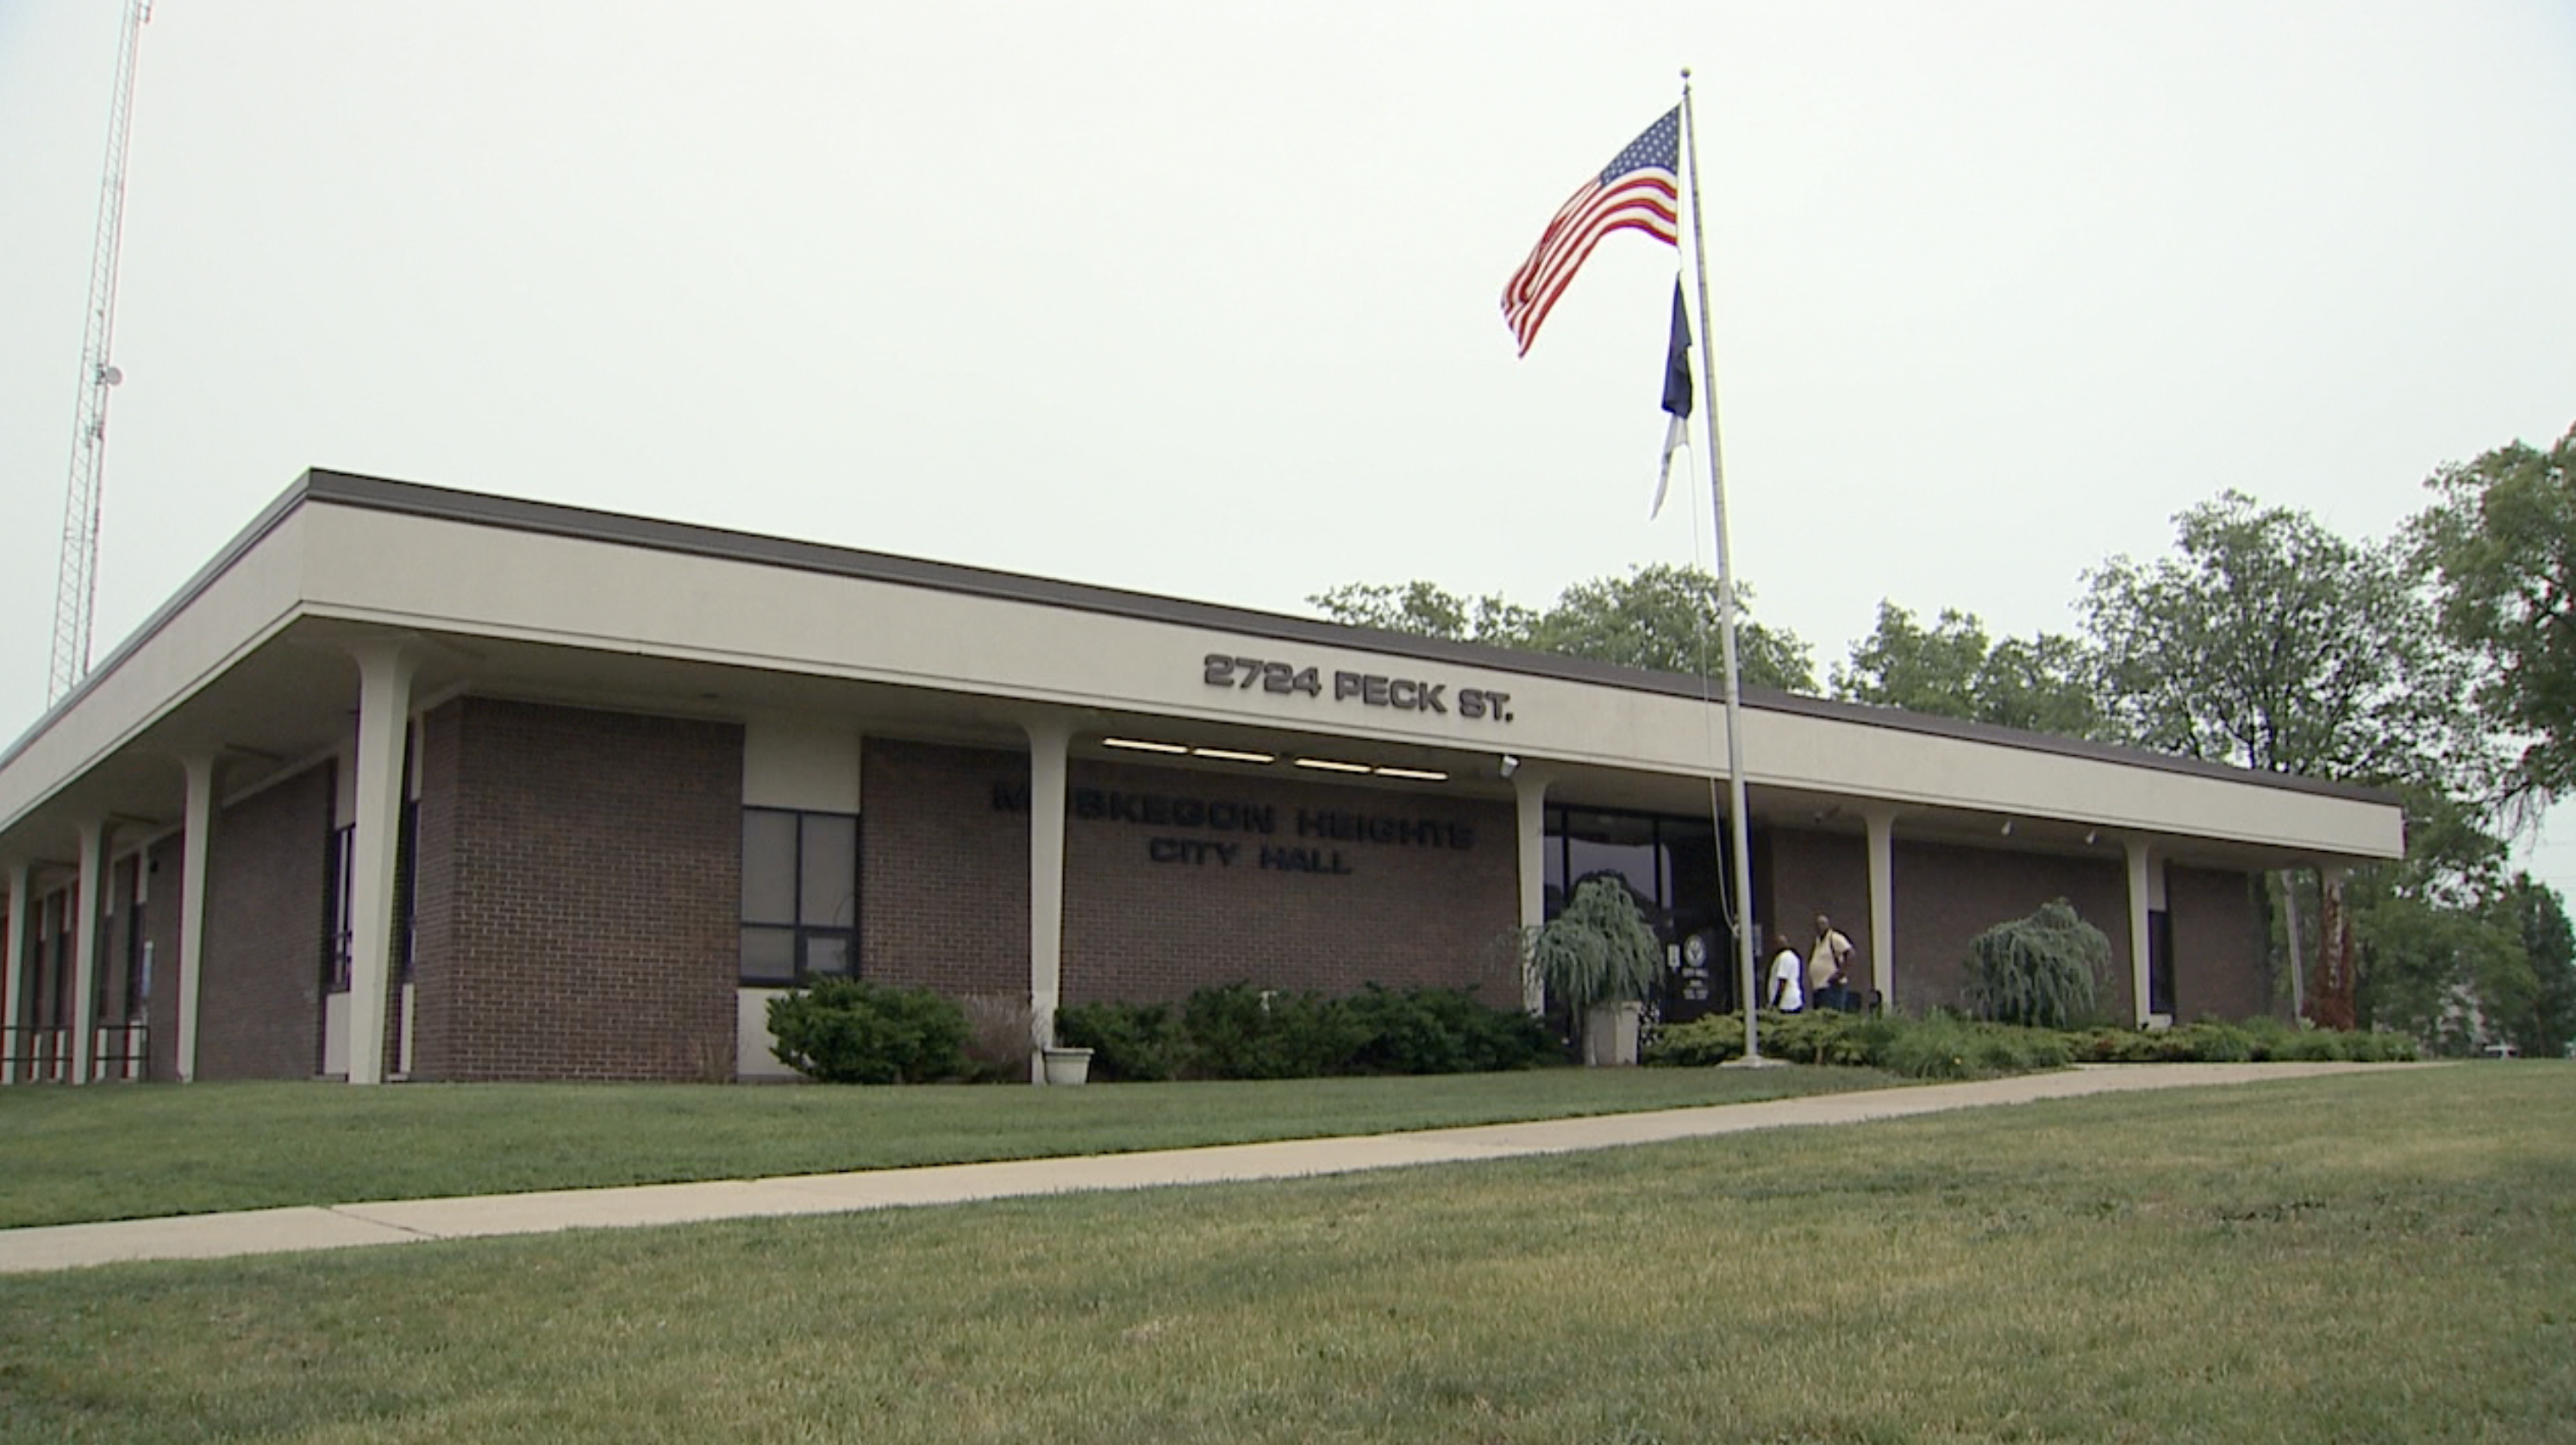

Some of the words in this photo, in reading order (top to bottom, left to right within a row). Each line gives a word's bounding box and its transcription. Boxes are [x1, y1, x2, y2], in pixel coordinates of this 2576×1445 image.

[1204, 654, 1322, 697] 2724
[1335, 670, 1447, 713] PECK
[1459, 688, 1514, 722] ST.
[991, 779, 1277, 835] MSKEGON
[1296, 807, 1476, 850] HEIGHTS
[1148, 836, 1239, 866] CITY
[1260, 842, 1353, 874] HALL
